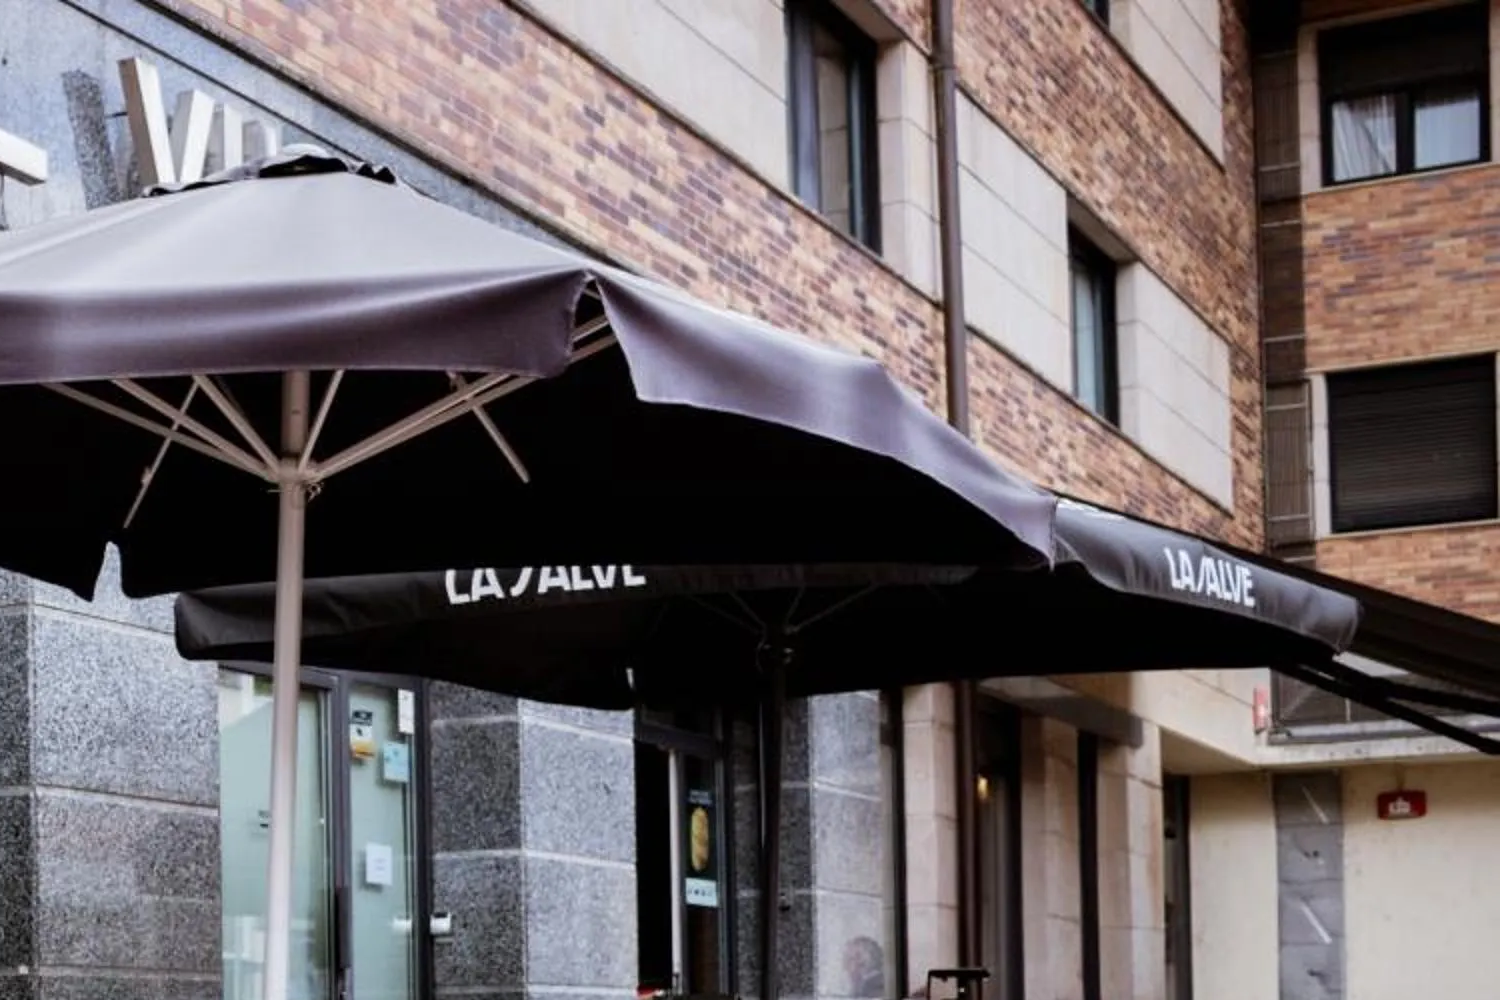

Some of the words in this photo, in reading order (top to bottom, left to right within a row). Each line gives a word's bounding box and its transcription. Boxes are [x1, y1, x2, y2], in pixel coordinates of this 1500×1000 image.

[445, 568, 505, 605] LA
[1164, 547, 1196, 592] LA
[1196, 555, 1255, 607] SALVE
